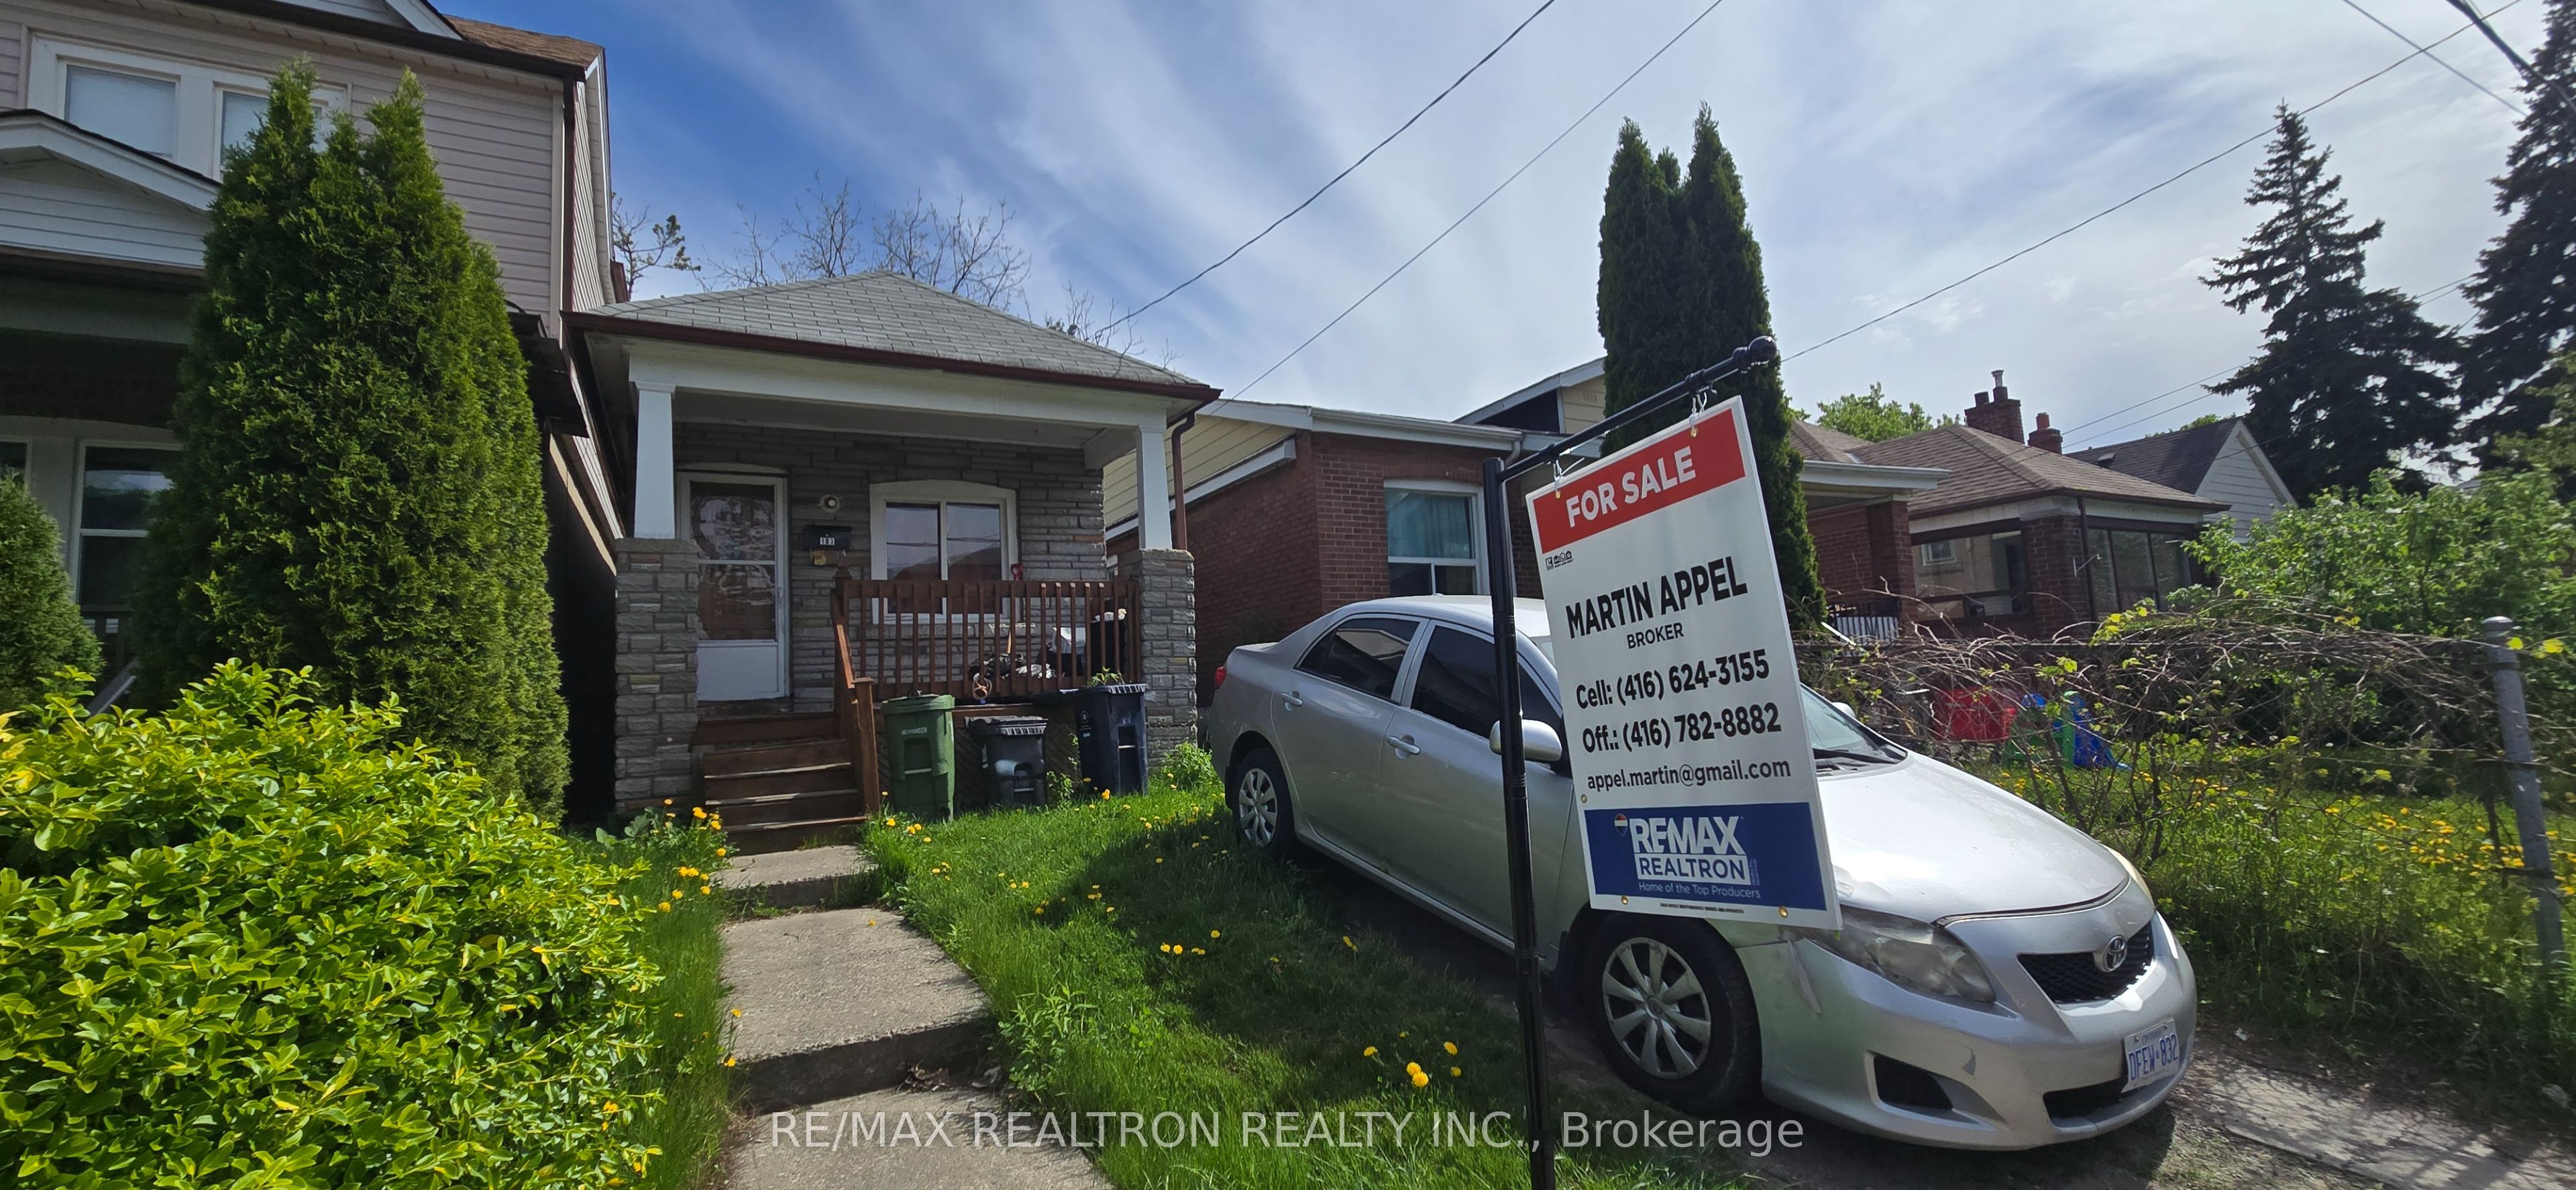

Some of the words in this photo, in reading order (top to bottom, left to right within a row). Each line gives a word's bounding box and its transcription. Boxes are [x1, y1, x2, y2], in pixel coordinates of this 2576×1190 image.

[1565, 482, 1618, 528] FOR
[1621, 445, 1697, 504] SALE
[1565, 581, 1654, 639] MARTIN
[1660, 555, 1748, 614] APPEL
[1626, 622, 1684, 649] BROKER
[1576, 678, 1613, 710] Cell:
[1617, 669, 1665, 707] (416)
[1669, 648, 1770, 694] 624-3155
[1582, 726, 1619, 753] Off.:
[1622, 717, 1670, 753] (416)
[1674, 702, 1782, 743] 782-8882
[1587, 759, 1791, 793] appel.martin@gmail.com
[1639, 857, 1746, 880] REALTRON
[1638, 881, 1664, 892] Home
[1665, 882, 1674, 893] of
[1676, 883, 1690, 894] the
[1691, 884, 1709, 897] Top
[1711, 885, 1762, 899] Producers
